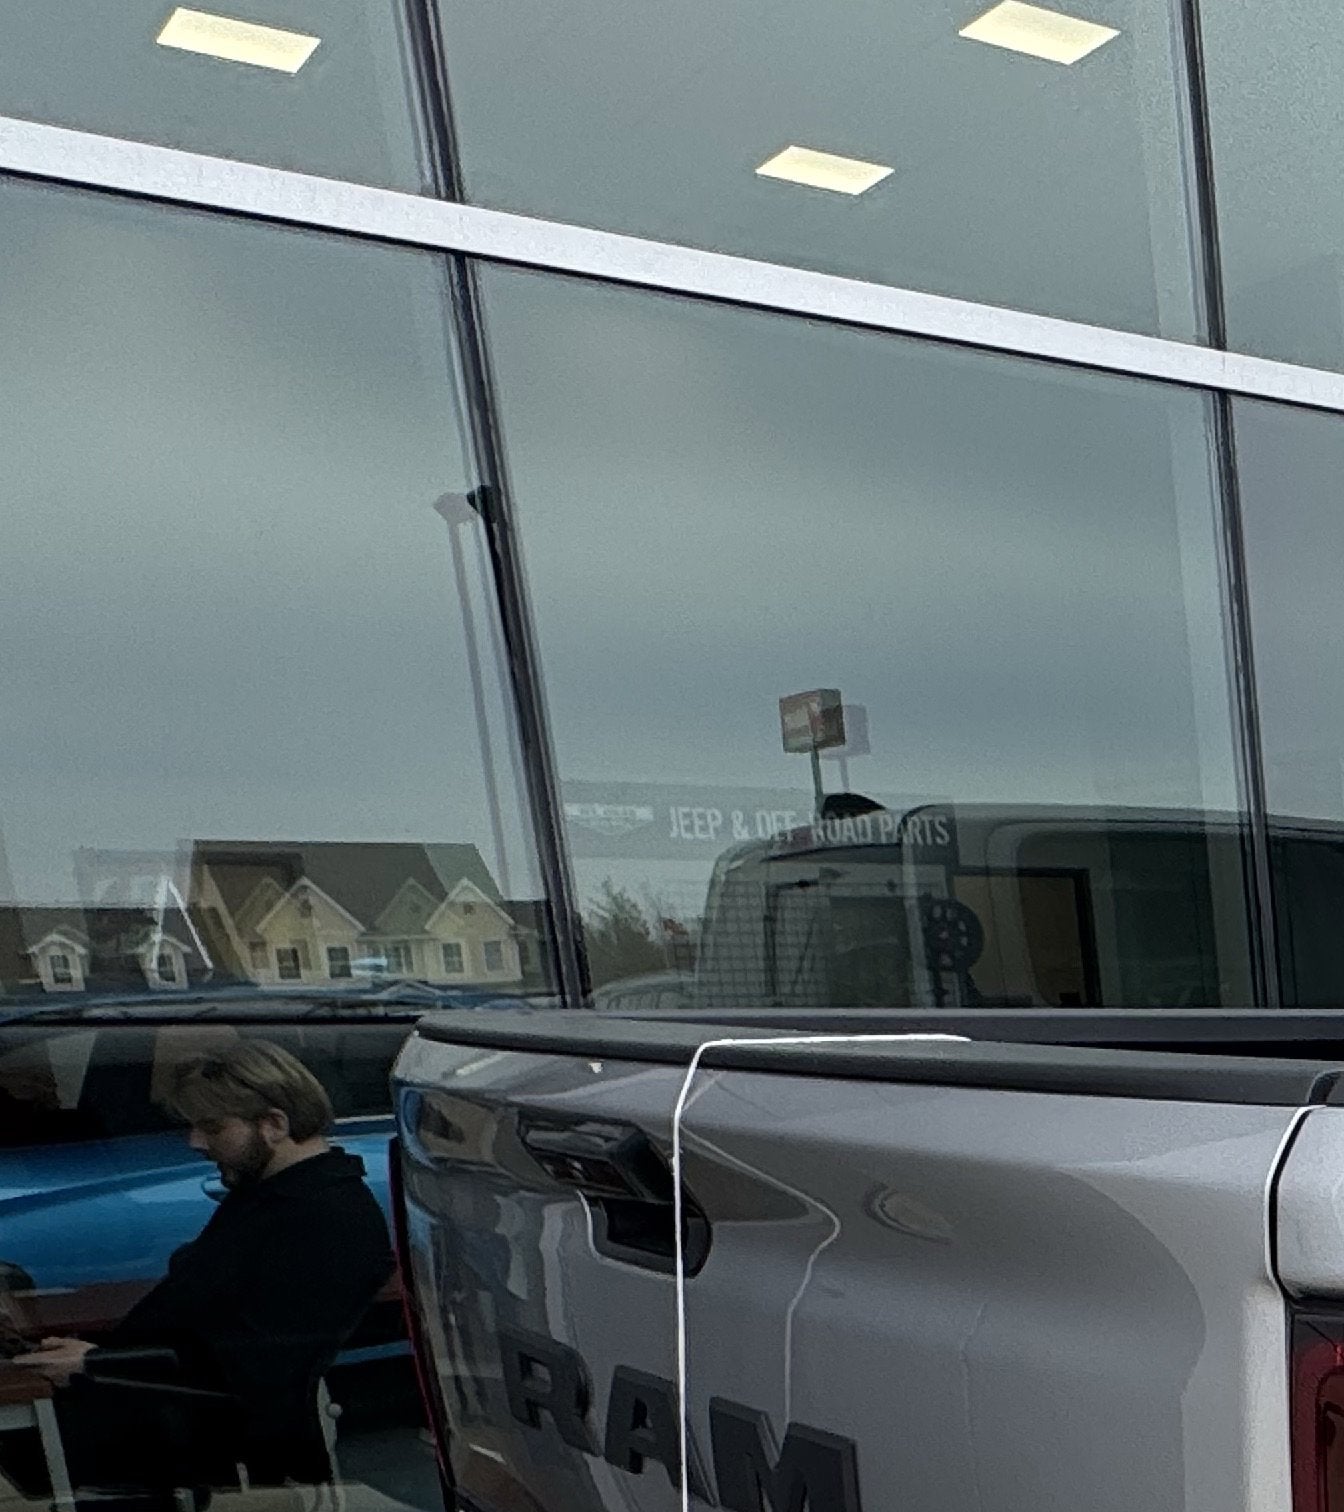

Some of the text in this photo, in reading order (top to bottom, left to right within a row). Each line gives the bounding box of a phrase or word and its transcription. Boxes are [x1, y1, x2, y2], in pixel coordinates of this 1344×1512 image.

[669, 806, 722, 841] JEEP
[731, 809, 750, 842] &
[878, 812, 949, 847] PARTS
